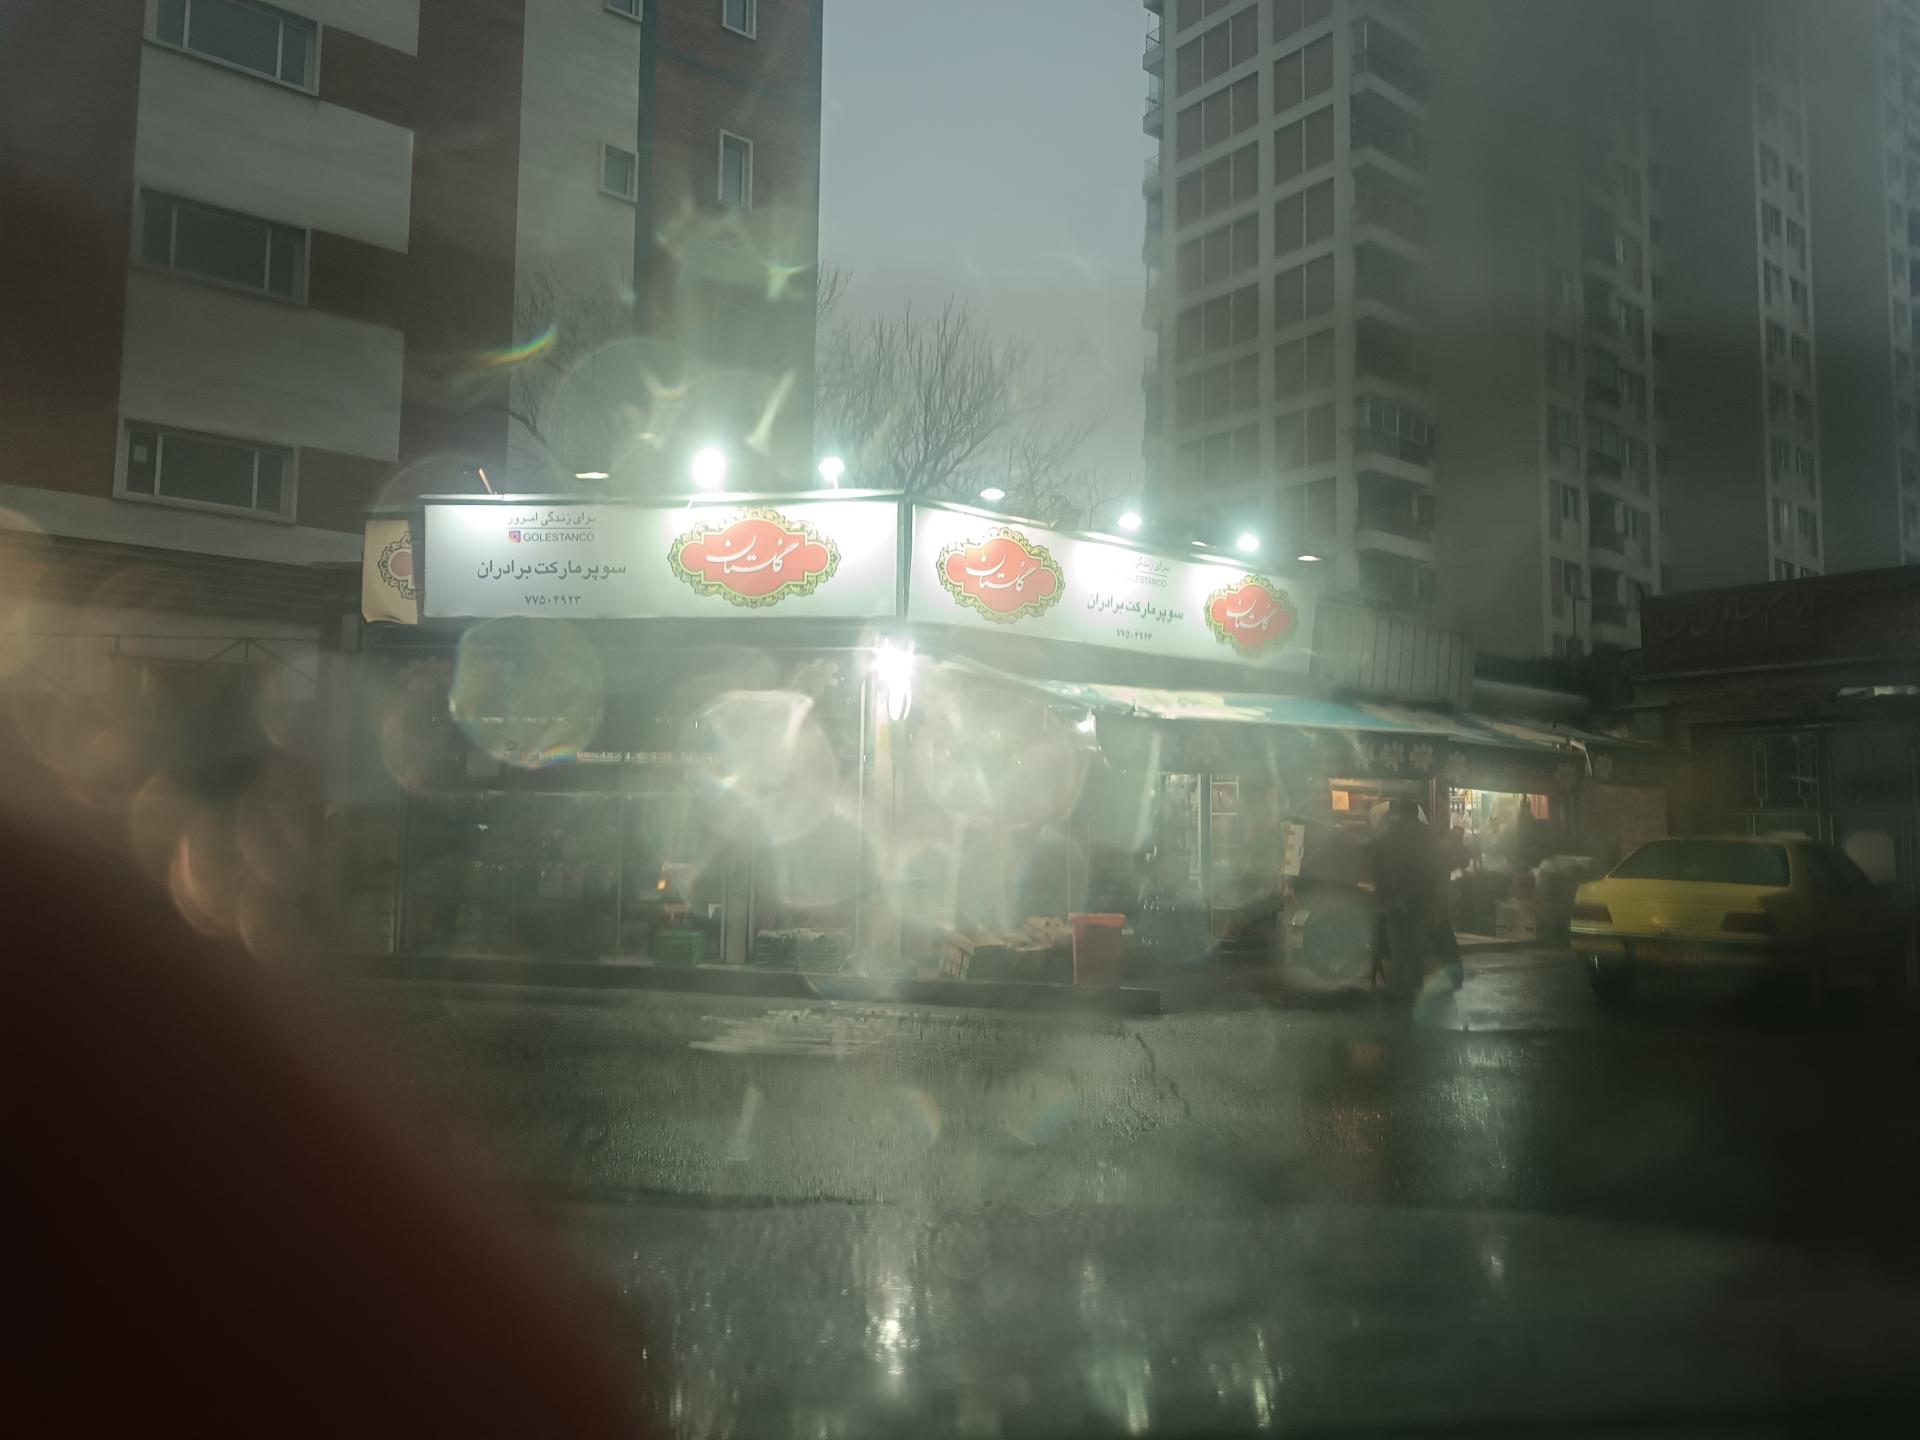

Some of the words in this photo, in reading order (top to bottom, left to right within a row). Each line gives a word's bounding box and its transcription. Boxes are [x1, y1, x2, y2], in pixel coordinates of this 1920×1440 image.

[523, 532, 595, 542] GOLESTANCO
[477, 560, 532, 580] برادران
[1087, 592, 1124, 615] برادران
